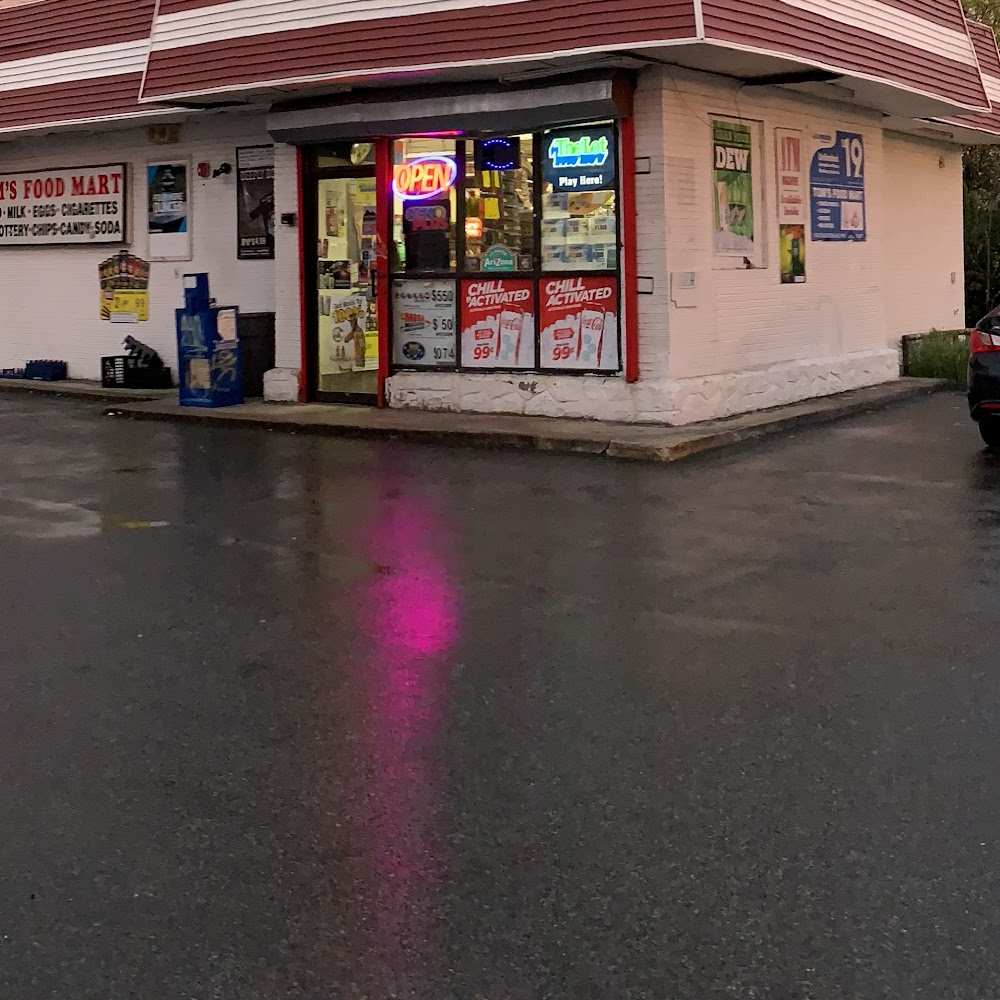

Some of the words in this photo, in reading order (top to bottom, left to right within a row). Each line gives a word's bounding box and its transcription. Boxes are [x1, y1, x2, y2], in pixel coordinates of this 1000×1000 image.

[715, 145, 749, 171] DEW
[841, 137, 863, 178] 19
[23, 177, 66, 200] FOOD
[71, 173, 122, 197] MART
[394, 164, 451, 192] OPEN
[559, 176, 578, 188] Play
[580, 175, 603, 186] Here!
[7, 205, 27, 219] MILK
[33, 203, 57, 218] EGGS
[61, 201, 118, 217] CIGARETTES
[31, 222, 57, 237] CHIPS
[95, 220, 121, 235] SODA
[467, 279, 505, 297] CHILL
[546, 277, 585, 296] CHILL
[467, 289, 530, 307] ACTIVATED
[545, 287, 612, 307] ACTIVATED
